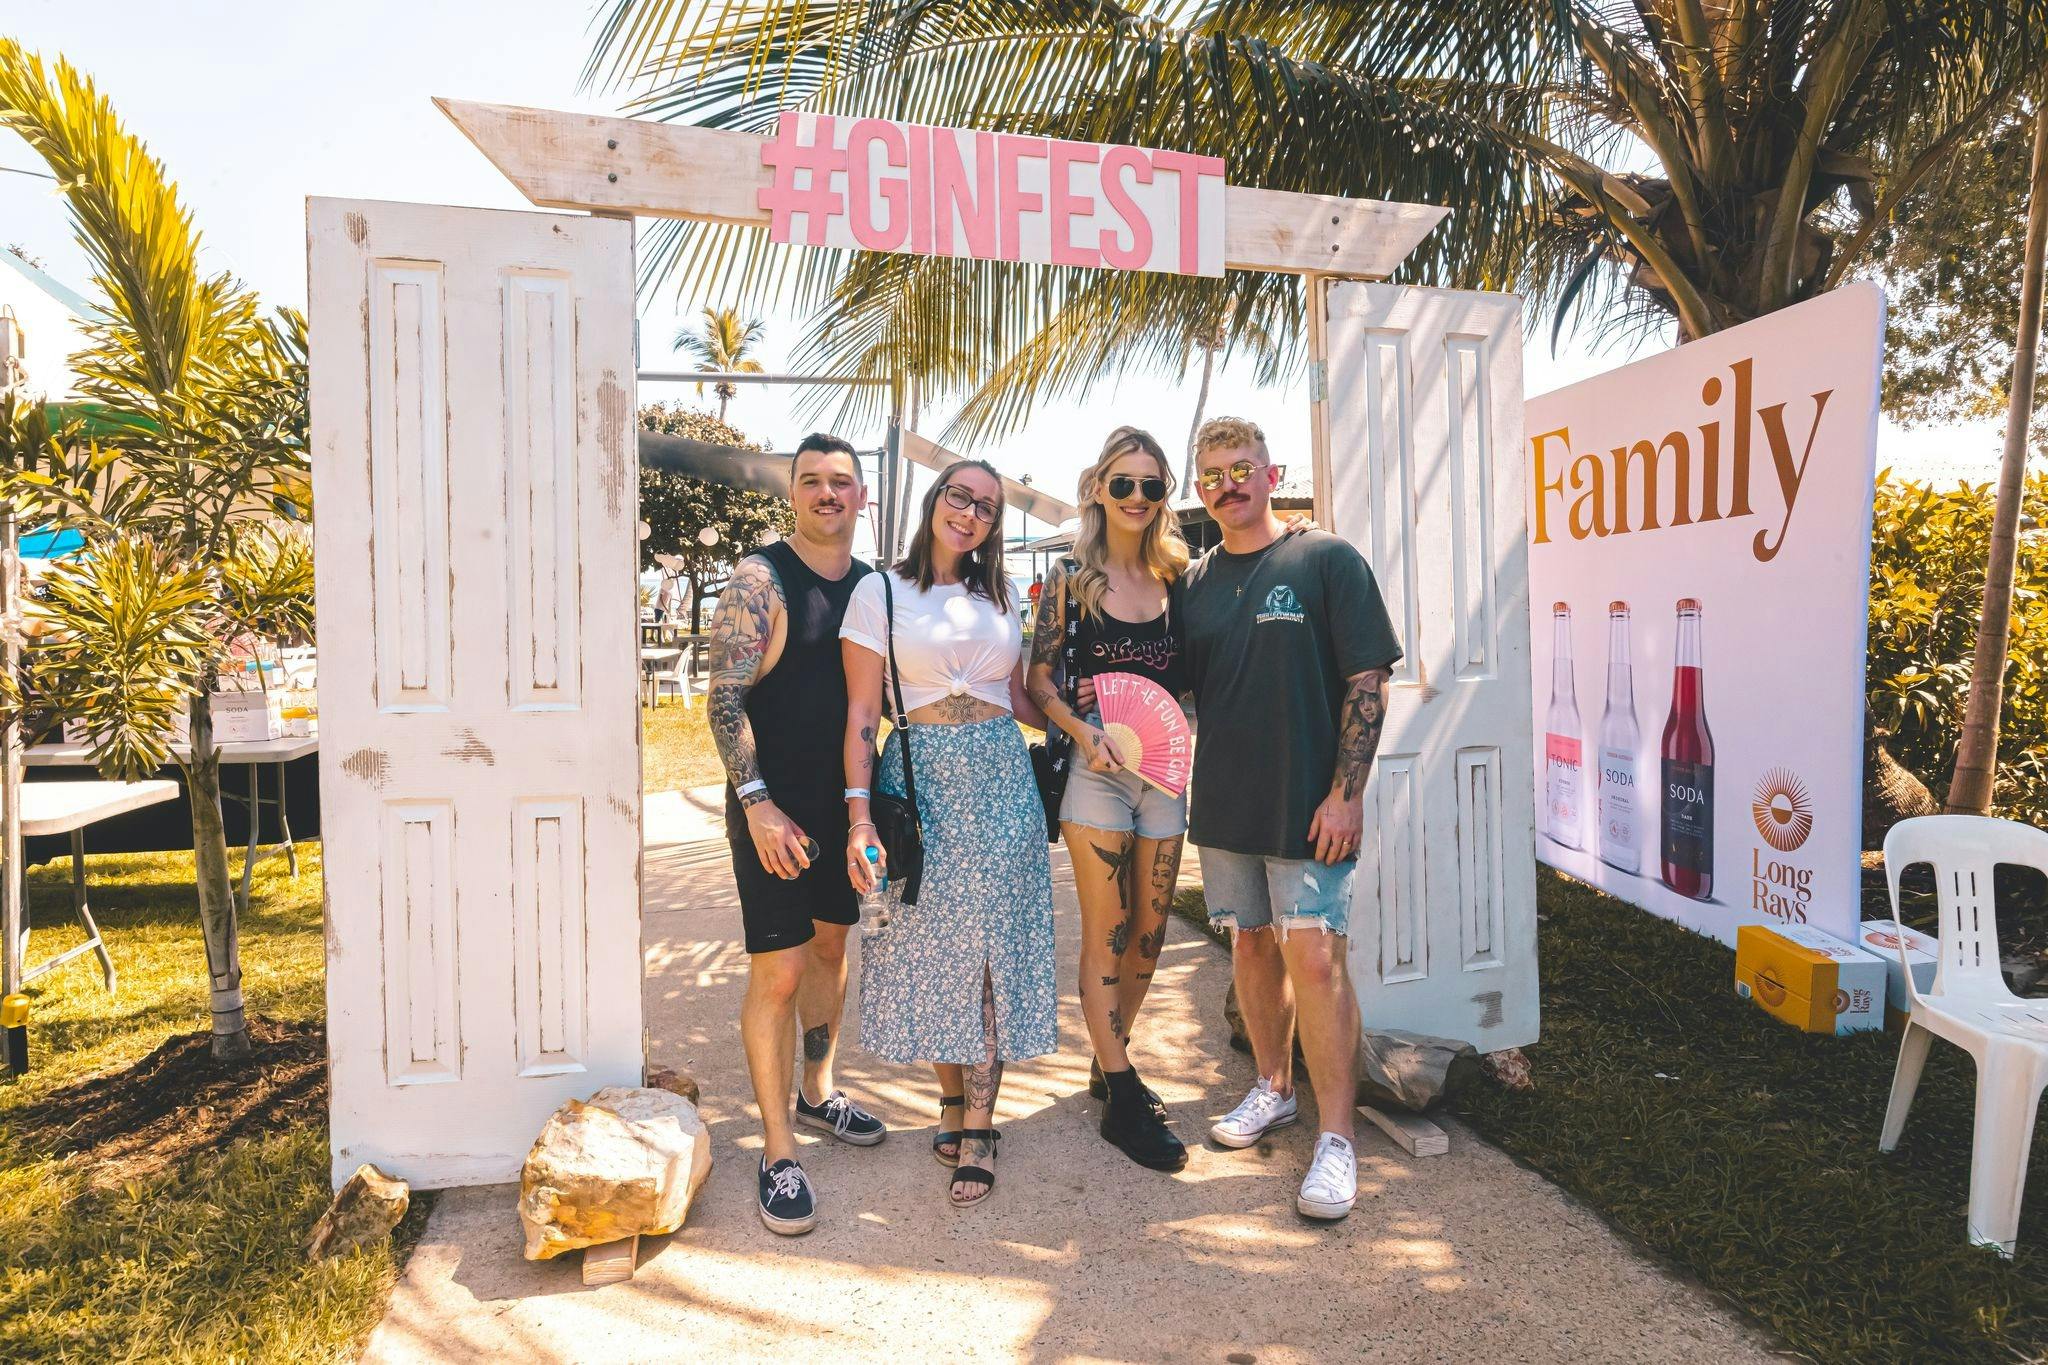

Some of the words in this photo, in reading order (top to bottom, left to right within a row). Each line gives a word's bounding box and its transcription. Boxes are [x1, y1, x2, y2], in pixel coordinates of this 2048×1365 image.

[757, 111, 1225, 275] #GINFEST
[1530, 357, 1834, 562] Family
[1089, 635, 1179, 670] Wrangl
[1102, 678, 1128, 696] LET
[1154, 699, 1180, 733] FUN
[1165, 735, 1186, 786] BEGIN
[1551, 753, 1578, 772] TONIC
[1606, 769, 1634, 787] SODA
[1670, 783, 1704, 805] SODA
[1753, 848, 1813, 902] Long
[1753, 880, 1807, 925] Rays
[1850, 989, 1864, 1014] Long
[1860, 990, 1873, 1014] Rays
